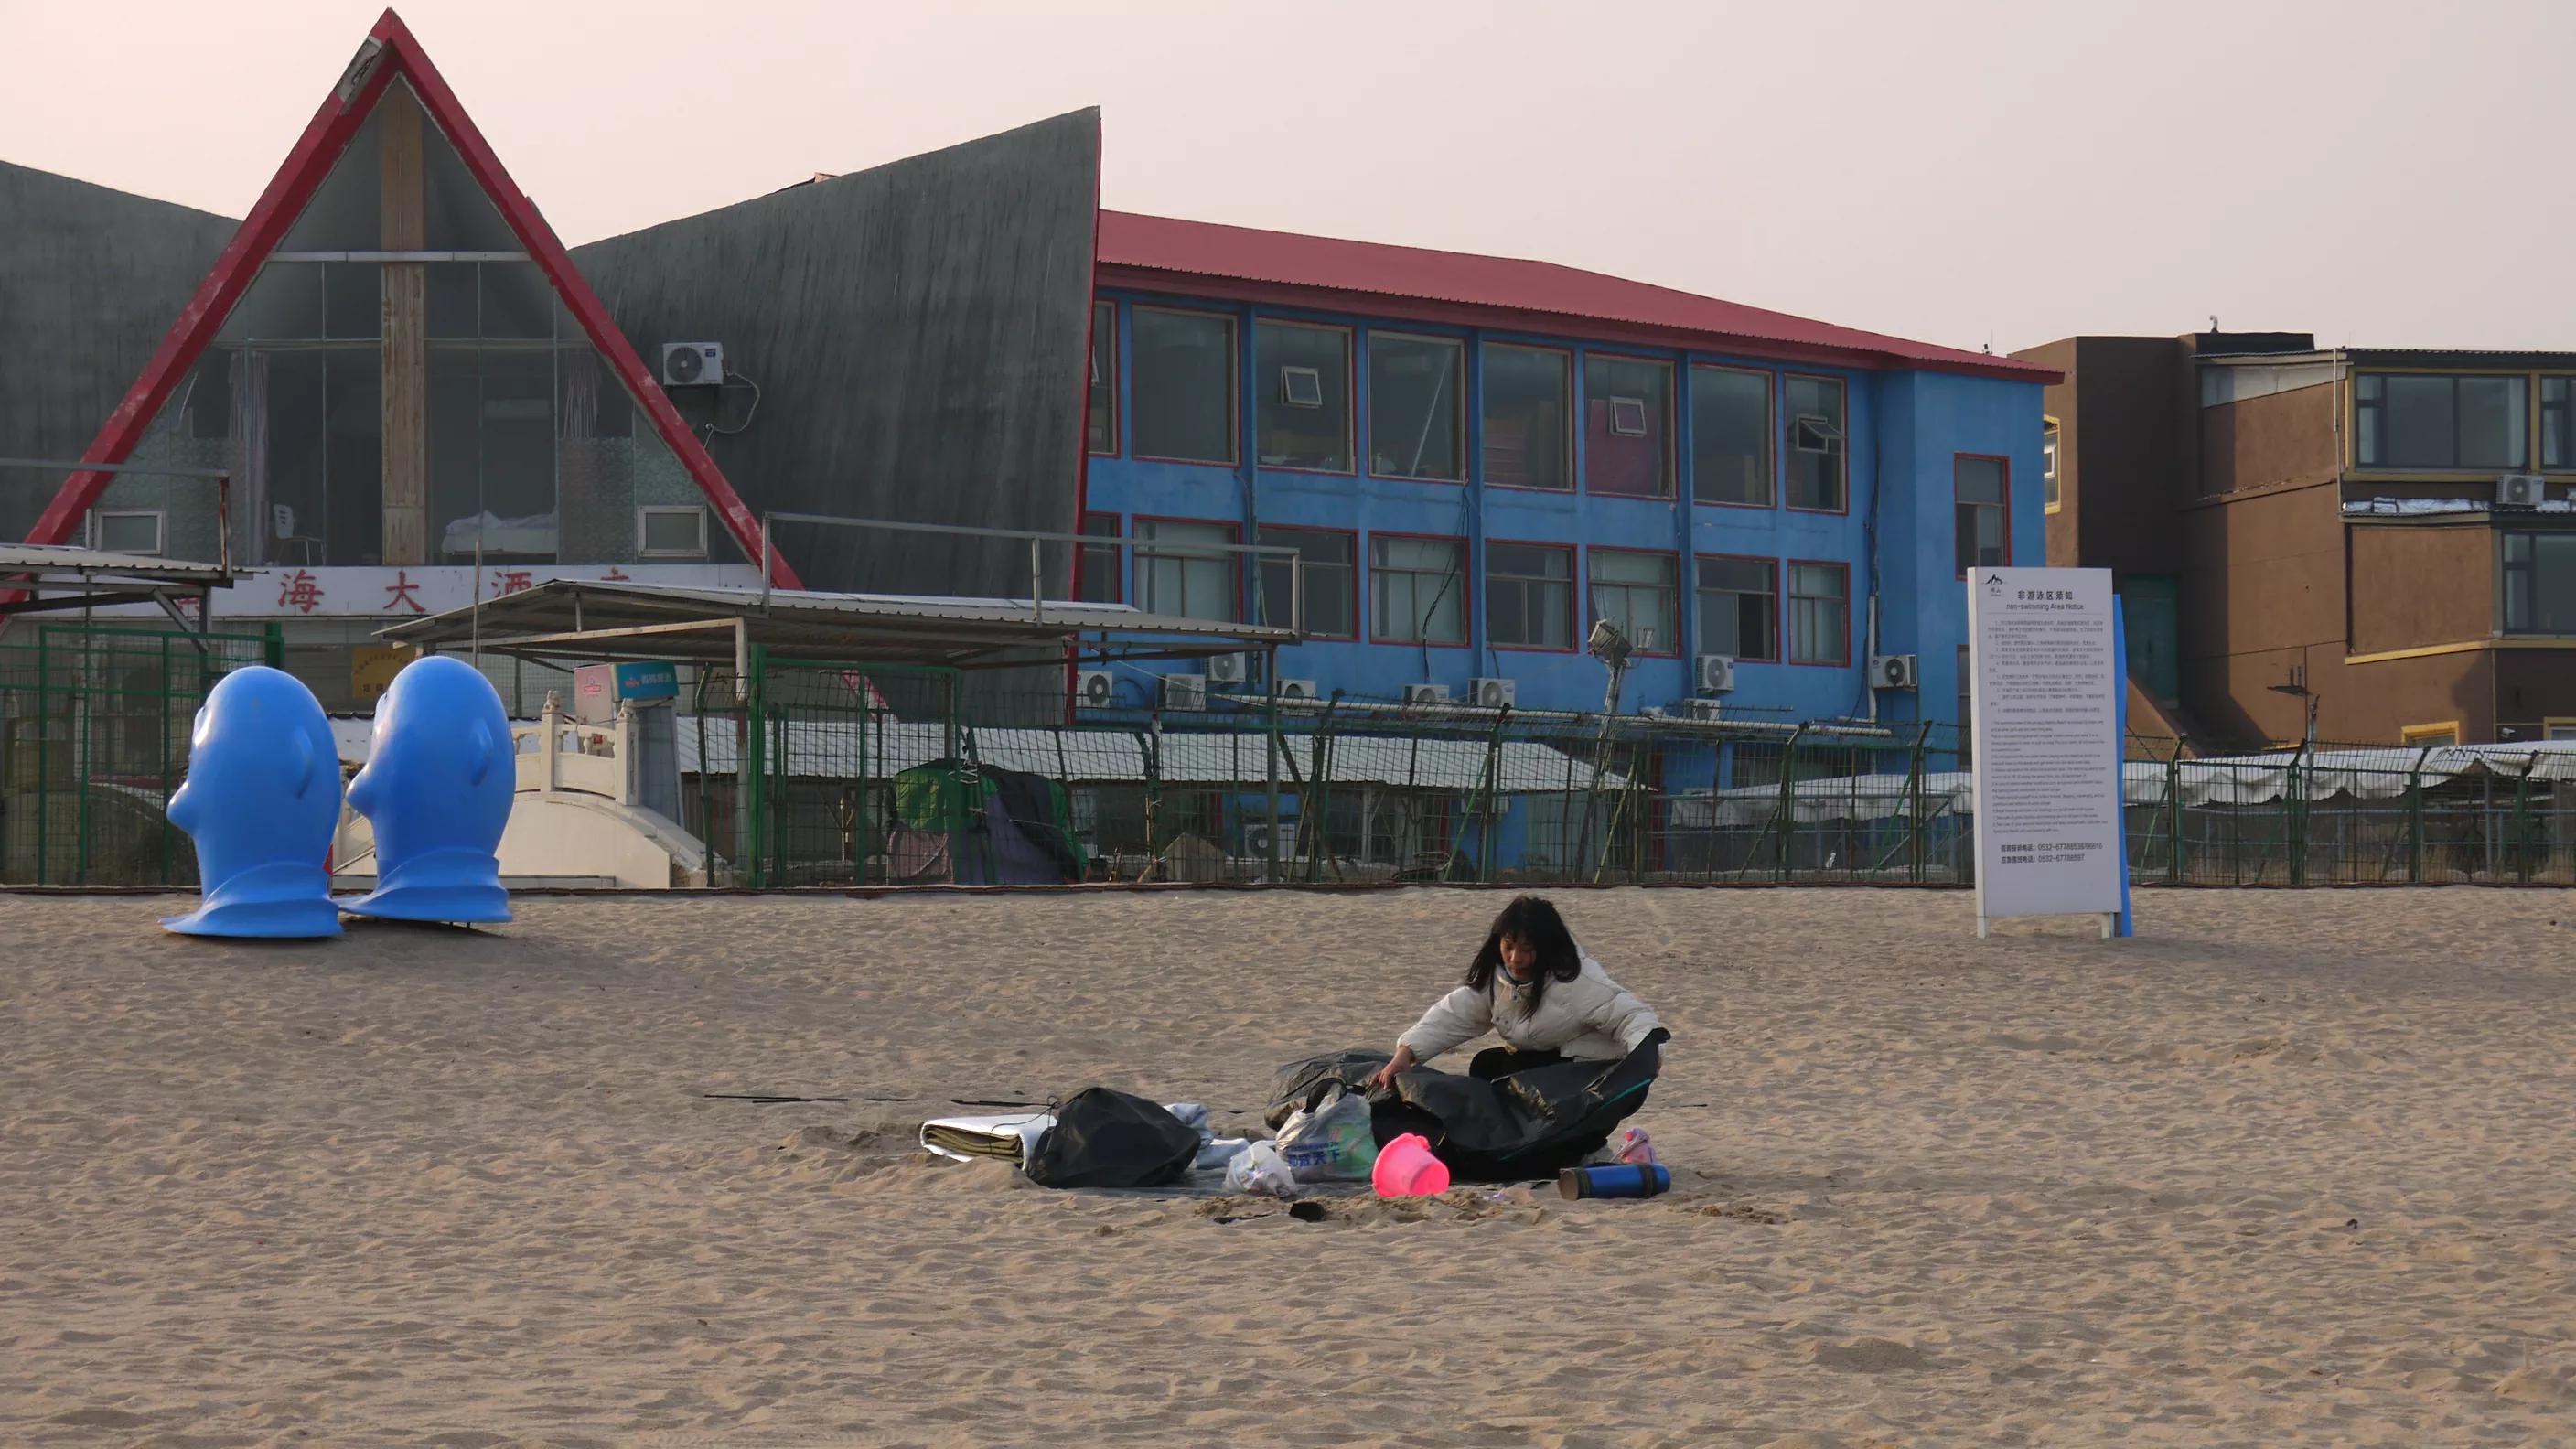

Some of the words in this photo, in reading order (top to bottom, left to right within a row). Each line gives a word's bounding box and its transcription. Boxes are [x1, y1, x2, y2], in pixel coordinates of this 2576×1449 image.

[2017, 590, 2073, 601] 非游泳区须知
[2006, 603, 2049, 611] non-swimming
